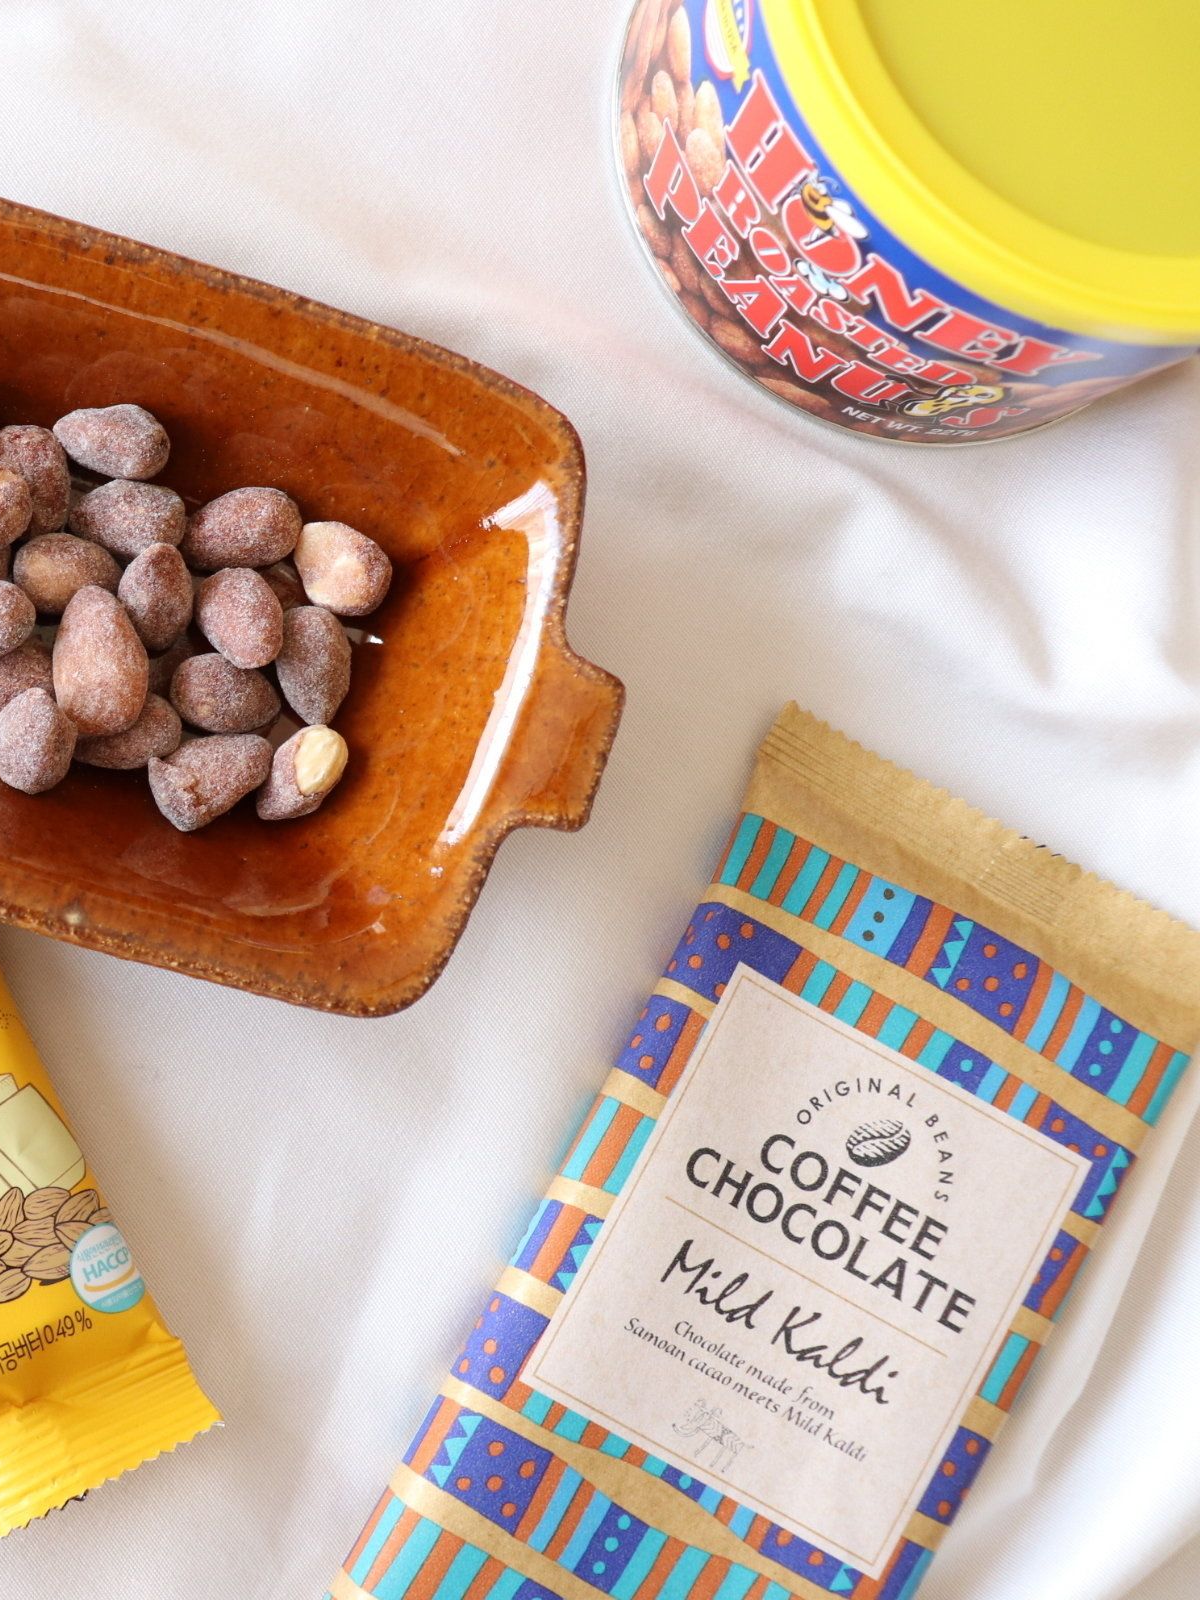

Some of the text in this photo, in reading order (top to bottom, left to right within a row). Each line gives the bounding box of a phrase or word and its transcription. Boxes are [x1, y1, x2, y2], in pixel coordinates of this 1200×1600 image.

[644, 116, 1030, 431] PEANUS
[712, 158, 980, 388] ROASTED
[724, 68, 1103, 377] HONEY
[841, 406, 886, 425] NET
[886, 420, 921, 434] WT.
[759, 1133, 949, 1262] COFFEE
[796, 1077, 954, 1203] ORIGINAL BEANS
[685, 1146, 977, 1335] CHOCOLATE
[624, 1317, 869, 1463] Samoan cacao meets Mild Kaldi
[660, 1239, 899, 1405] Mild Kaldi
[673, 1320, 836, 1421] Chocolate made from
